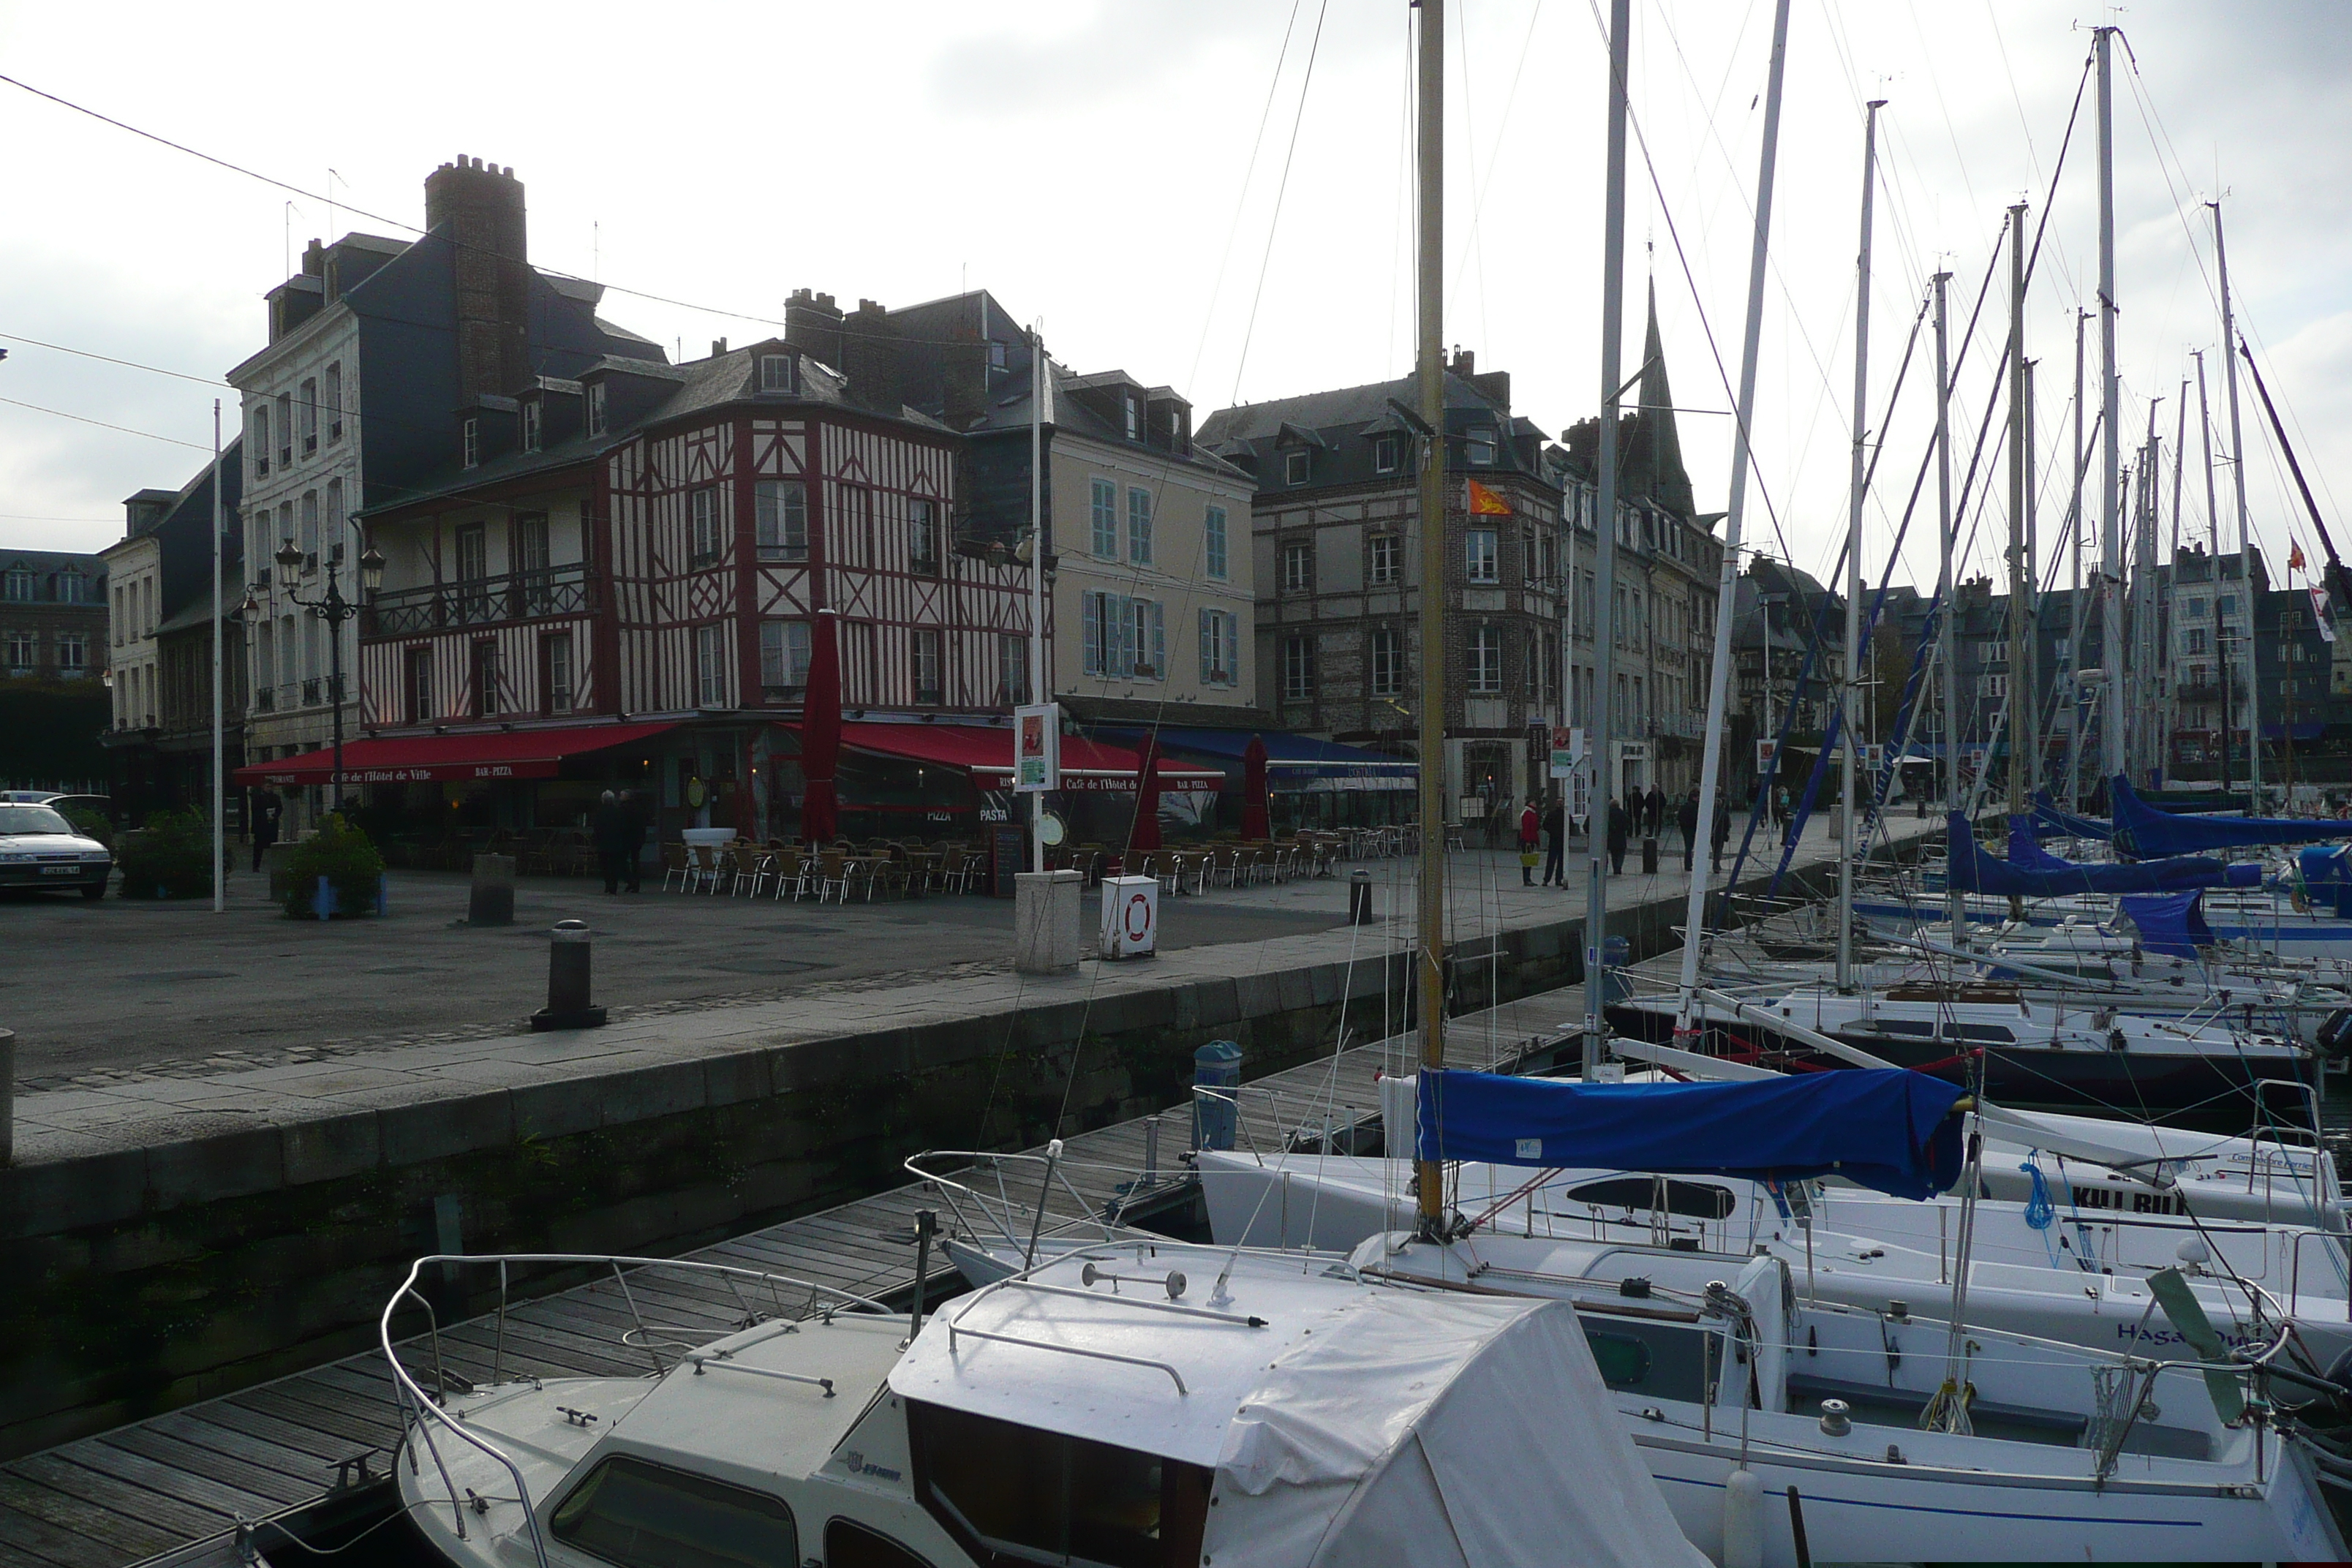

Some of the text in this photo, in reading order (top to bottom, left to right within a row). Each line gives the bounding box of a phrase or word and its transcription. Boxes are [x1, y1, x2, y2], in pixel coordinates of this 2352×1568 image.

[331, 769, 432, 783] Cfé de l'Hôtel de Ville
[1088, 779, 1098, 790] de
[1100, 777, 1127, 790] l'Hôtel
[927, 811, 951, 822] PIZZA
[979, 809, 1008, 822] PASTA
